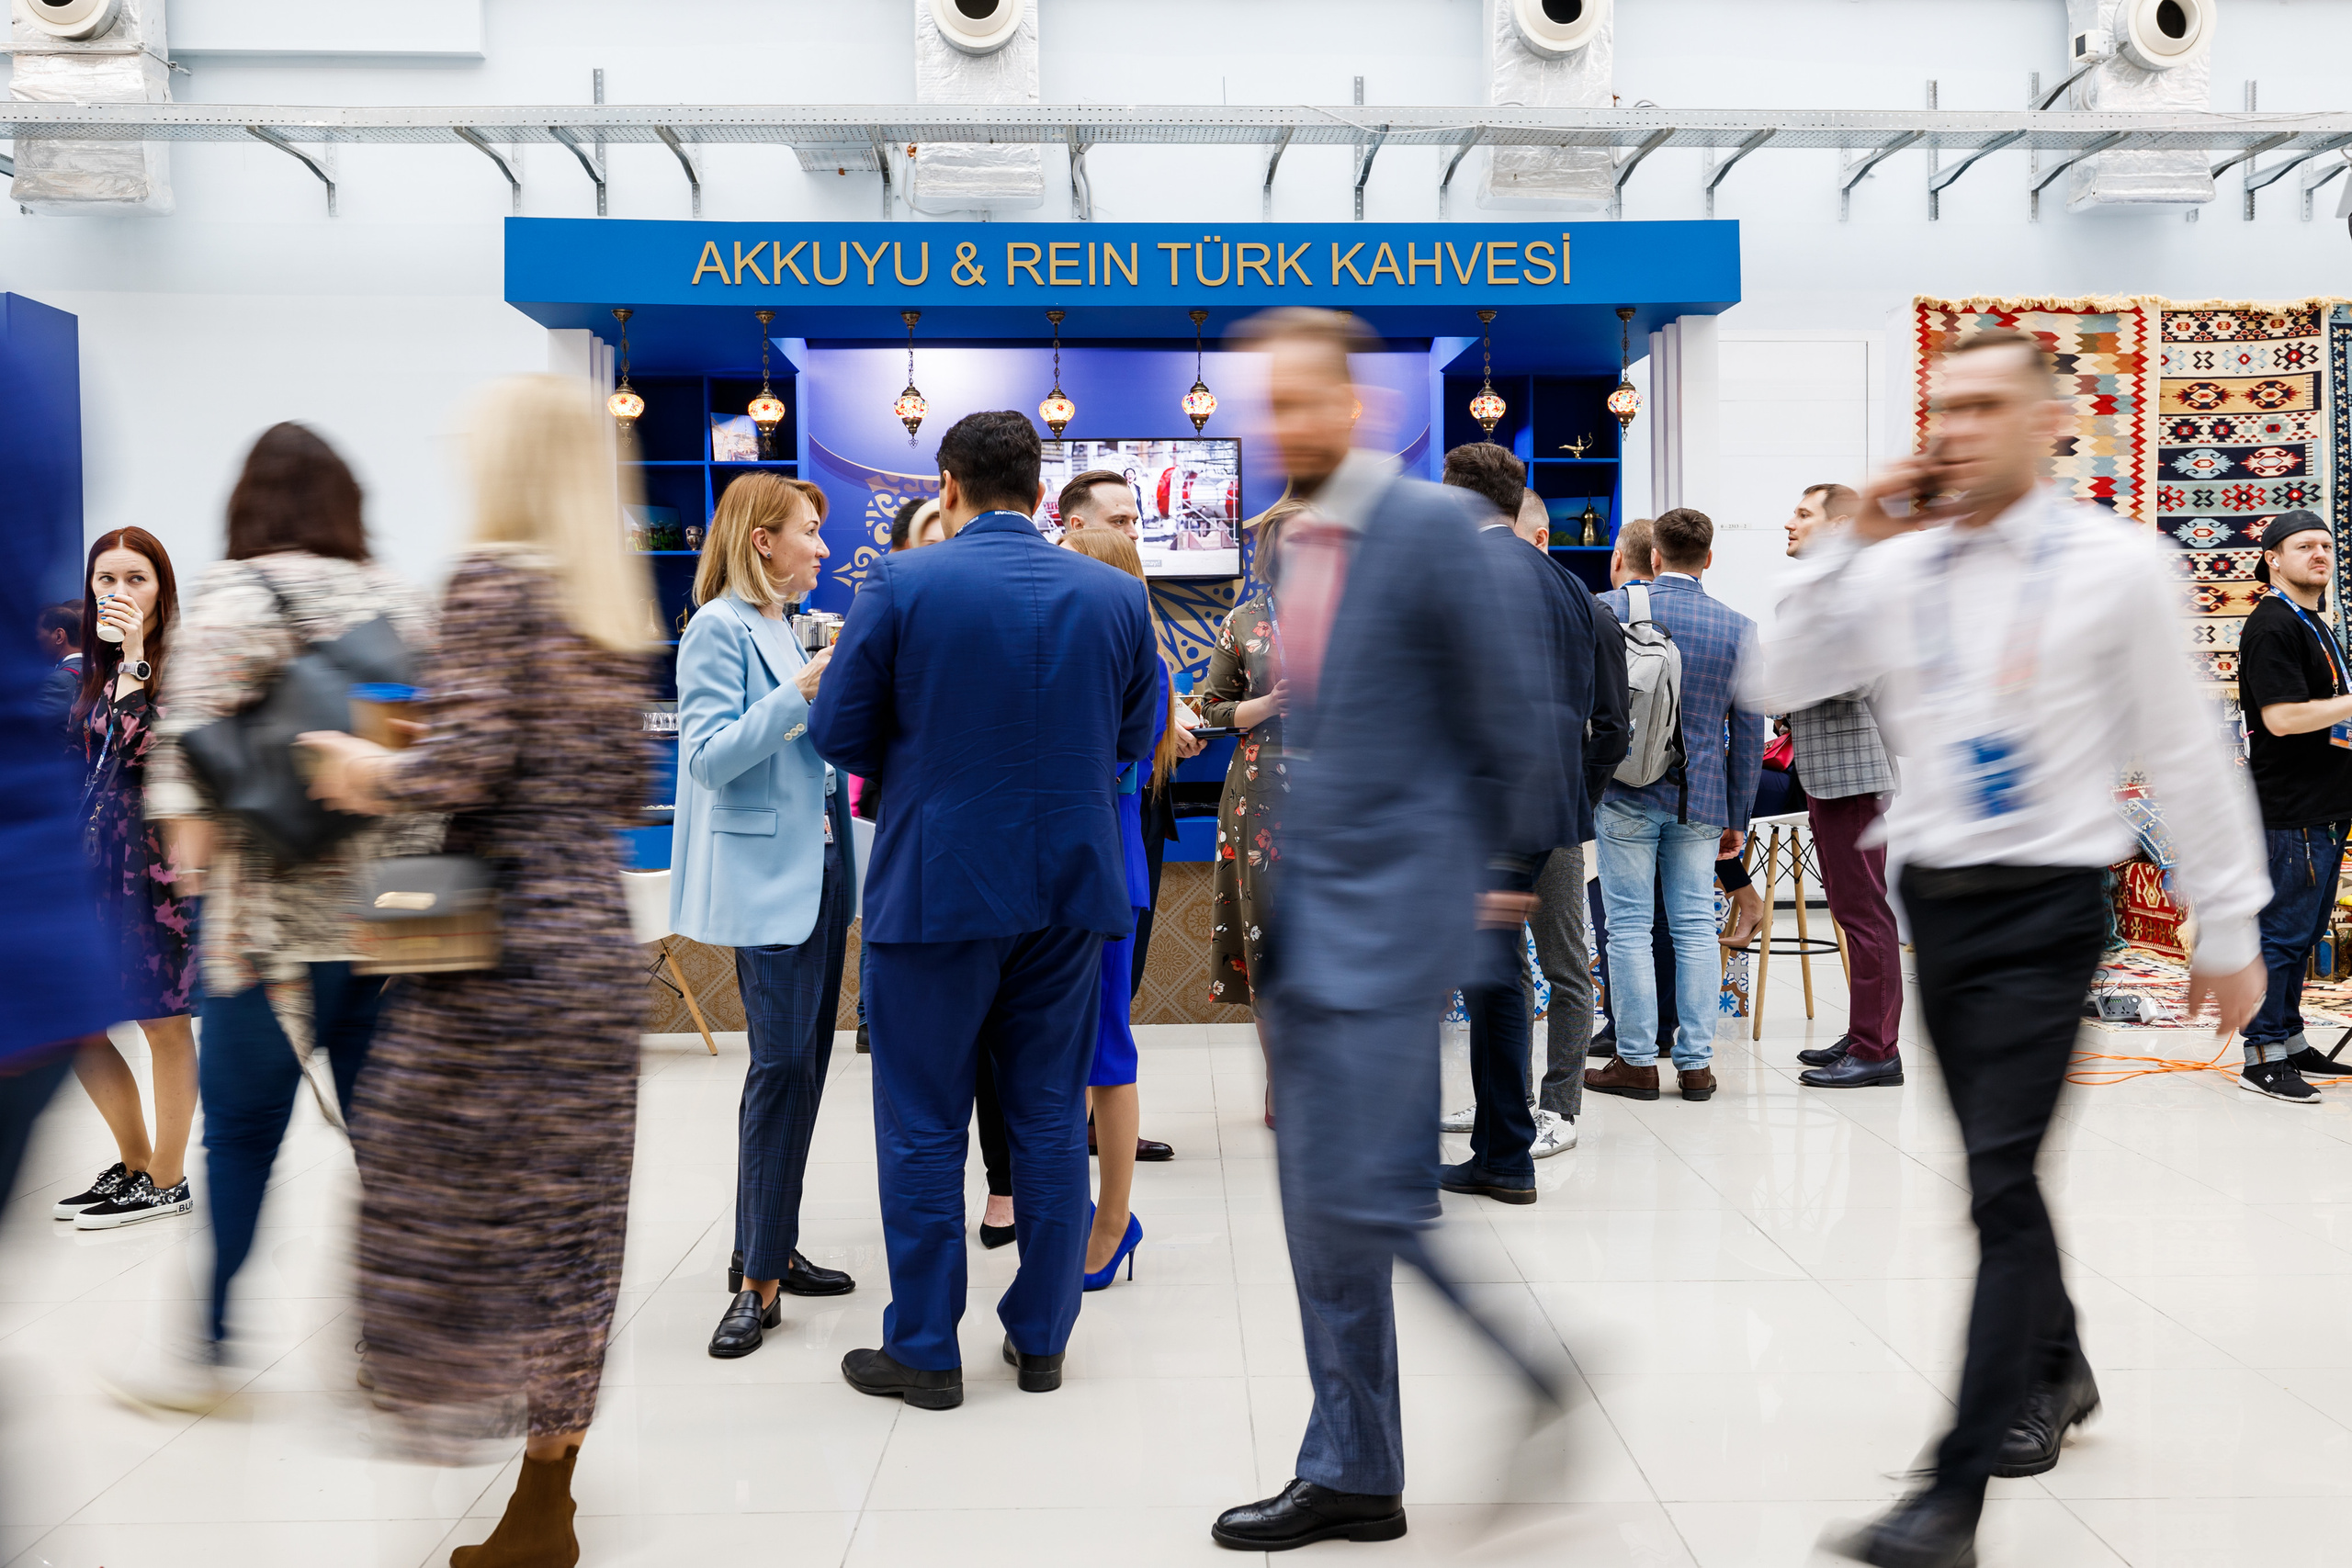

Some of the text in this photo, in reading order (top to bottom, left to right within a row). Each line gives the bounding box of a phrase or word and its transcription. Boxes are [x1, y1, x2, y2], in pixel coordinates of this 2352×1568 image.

[691, 233, 1571, 287] AKKUYU & REIN TÜRK KAHVESİ
